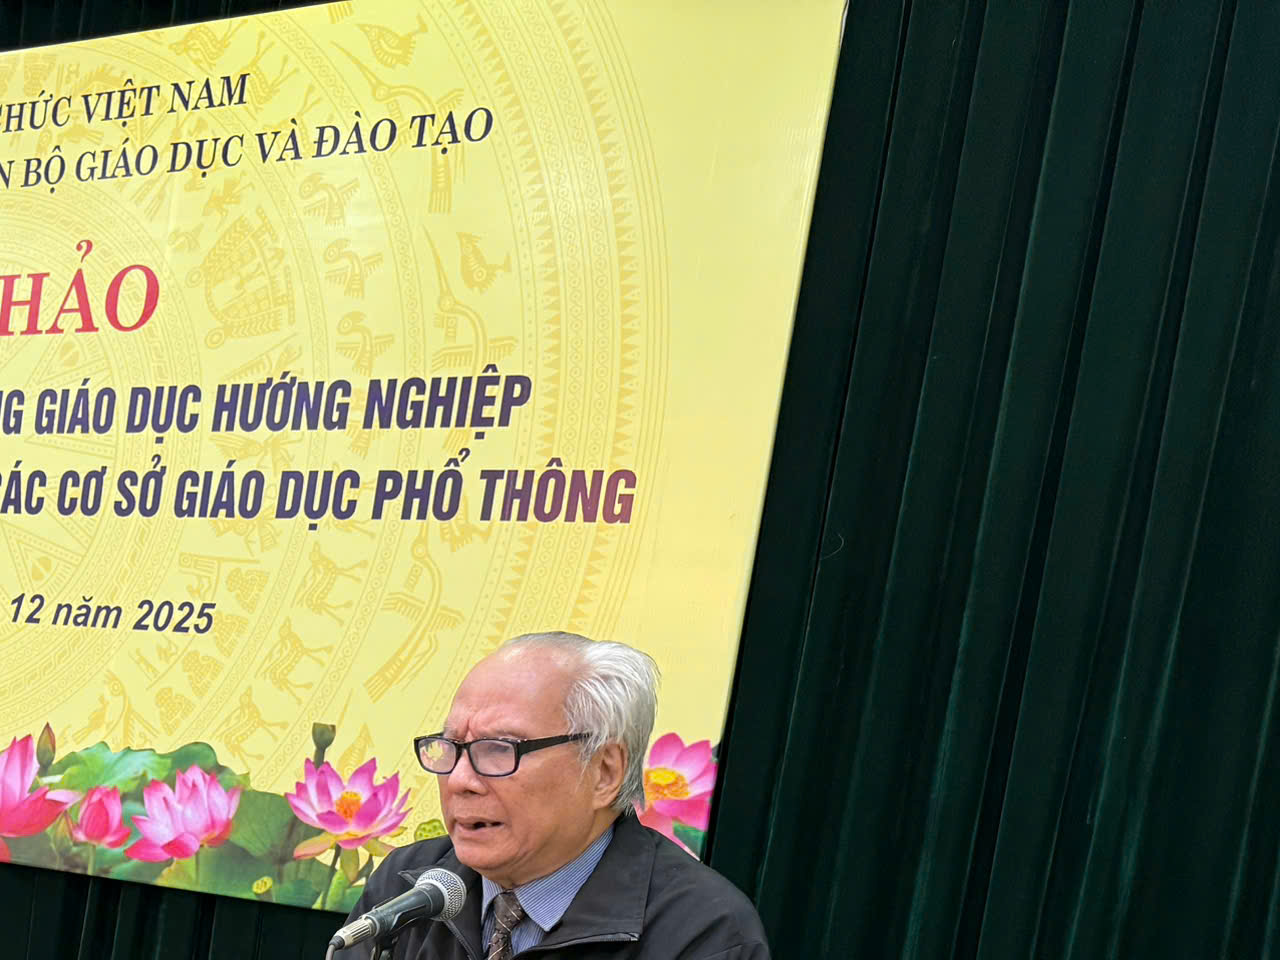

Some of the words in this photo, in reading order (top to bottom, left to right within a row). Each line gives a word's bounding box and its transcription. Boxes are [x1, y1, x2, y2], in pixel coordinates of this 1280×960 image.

[81, 79, 160, 127] VIỆT
[167, 73, 250, 113] NAM
[21, 145, 65, 193] BỘ
[76, 138, 158, 181] GIÁO
[167, 135, 244, 178] DỤC
[255, 118, 302, 163] VÀ
[312, 111, 397, 158] ĐÀO
[410, 108, 493, 154] TẠO
[35, 378, 116, 434] GIÁO
[126, 385, 201, 444] DỤC
[212, 371, 351, 432] HƯỚNG
[363, 364, 532, 439] NGHIỆP
[57, 466, 107, 516] CƠ
[114, 454, 166, 517] SỞ
[174, 460, 264, 519] GIÁO
[275, 470, 360, 530] DỤC
[371, 448, 470, 521] PHỔ
[480, 458, 636, 523] THÔNG
[11, 593, 44, 624] 12
[52, 596, 122, 628] năm
[133, 600, 216, 634] 2025
